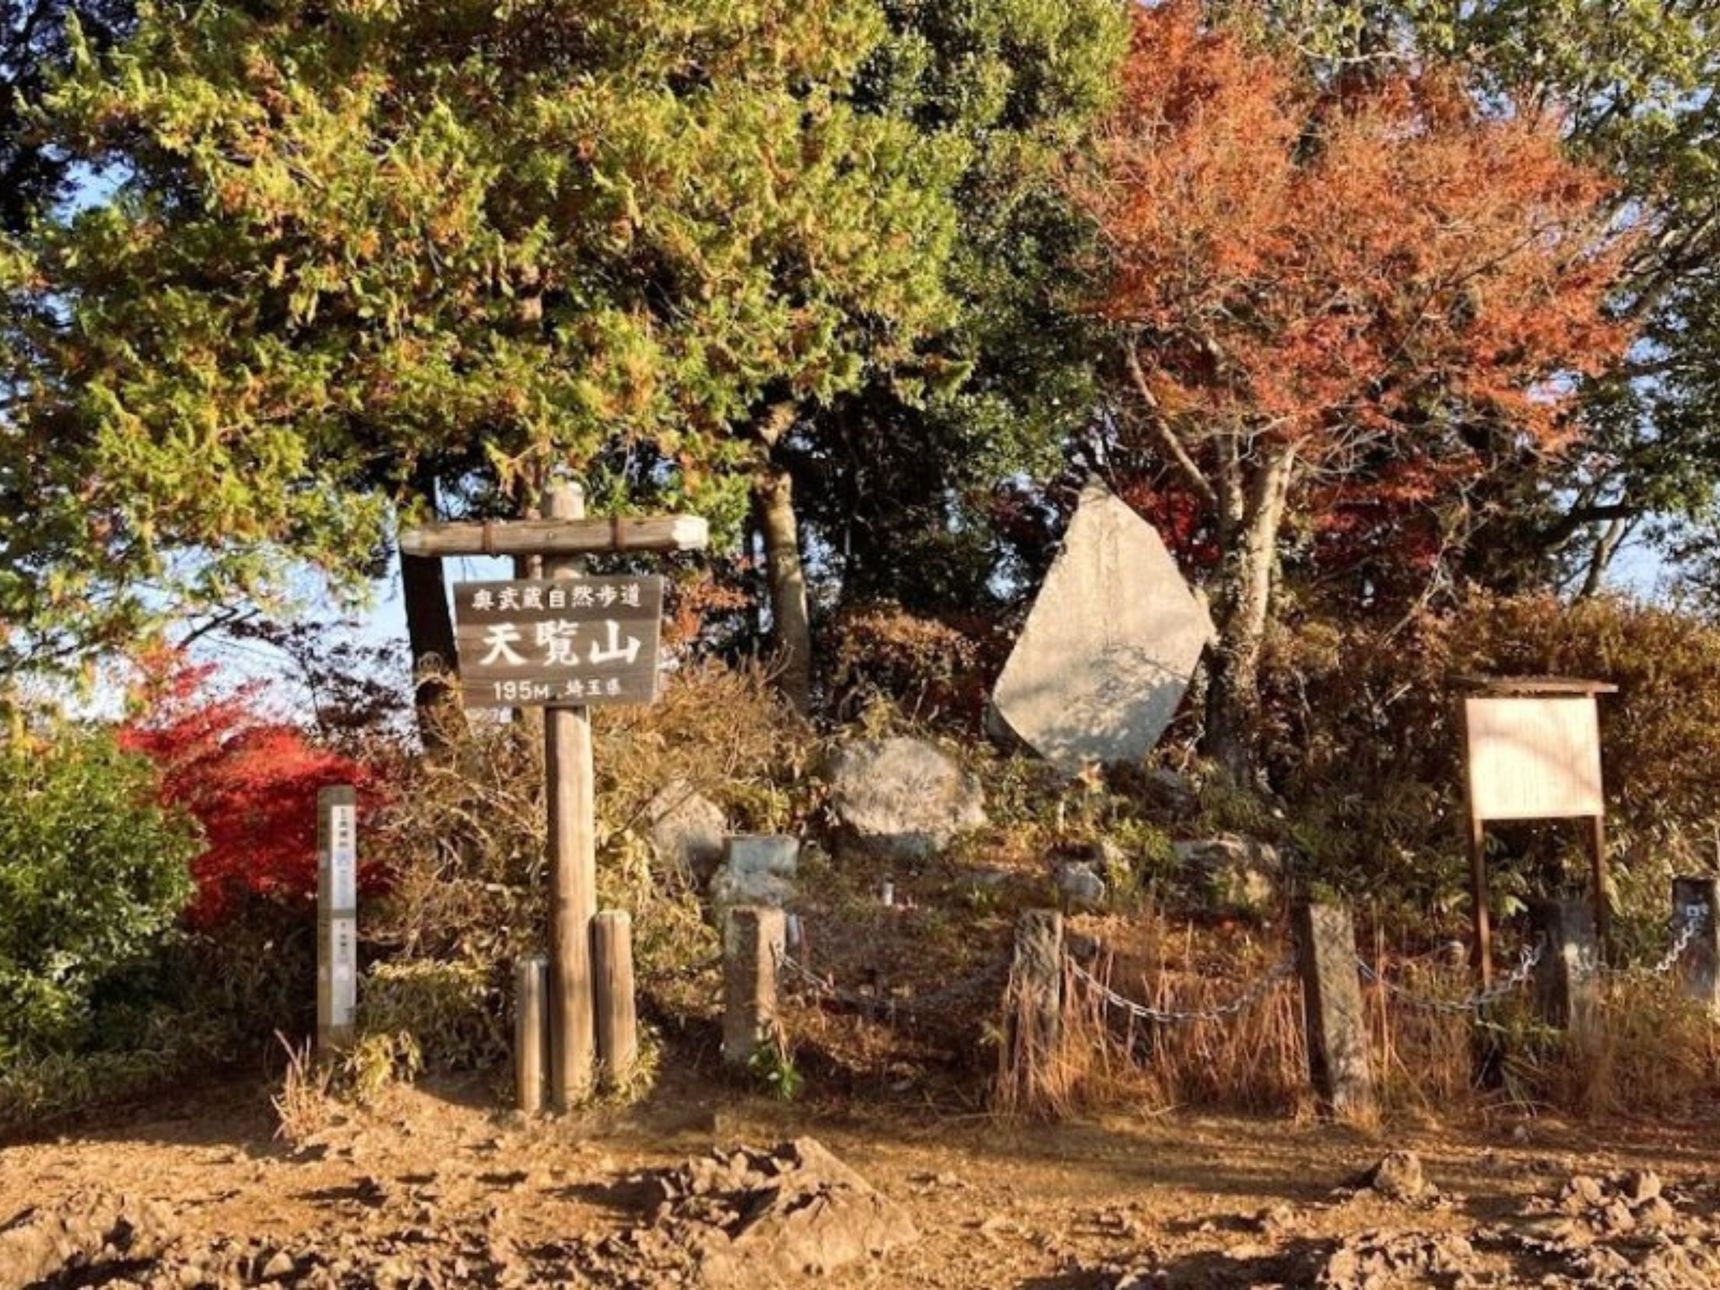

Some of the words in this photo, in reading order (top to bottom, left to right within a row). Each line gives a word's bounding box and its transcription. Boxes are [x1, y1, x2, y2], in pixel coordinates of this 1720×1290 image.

[479, 618, 642, 666] 天覧山
[564, 677, 622, 698] 埼玉県
